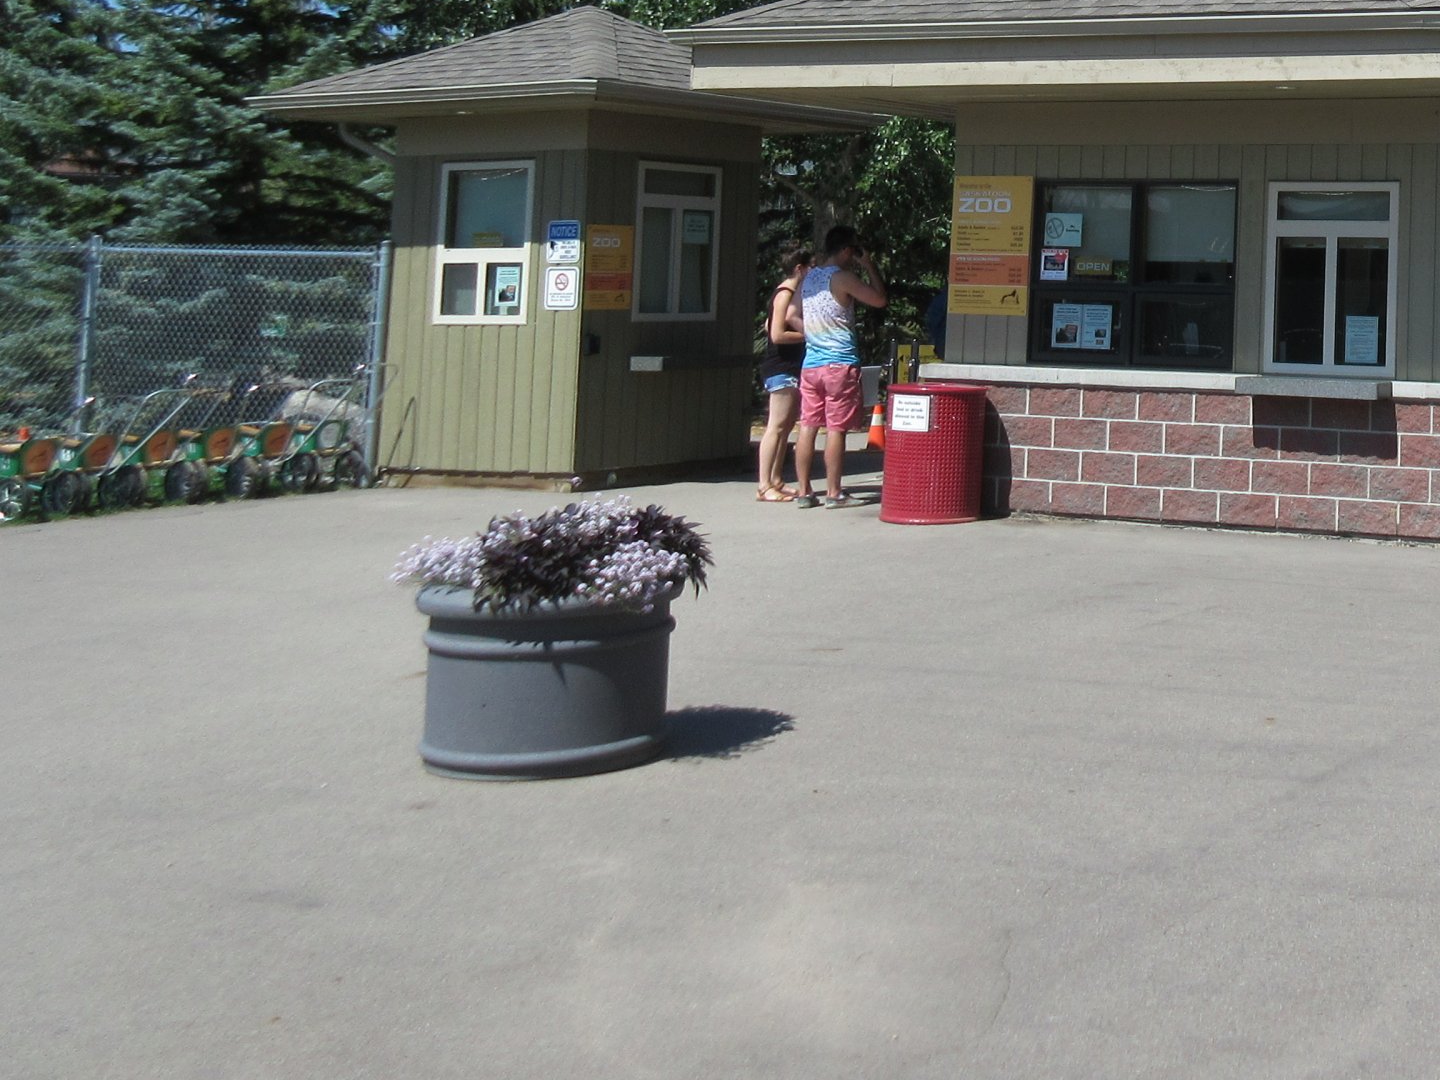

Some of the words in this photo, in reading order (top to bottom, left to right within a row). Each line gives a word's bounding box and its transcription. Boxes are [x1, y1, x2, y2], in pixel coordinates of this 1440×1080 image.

[959, 197, 1012, 213] ZOO
[550, 226, 577, 238] NOTICE
[592, 237, 621, 248] ZOO
[1077, 262, 1110, 271] OPEN
